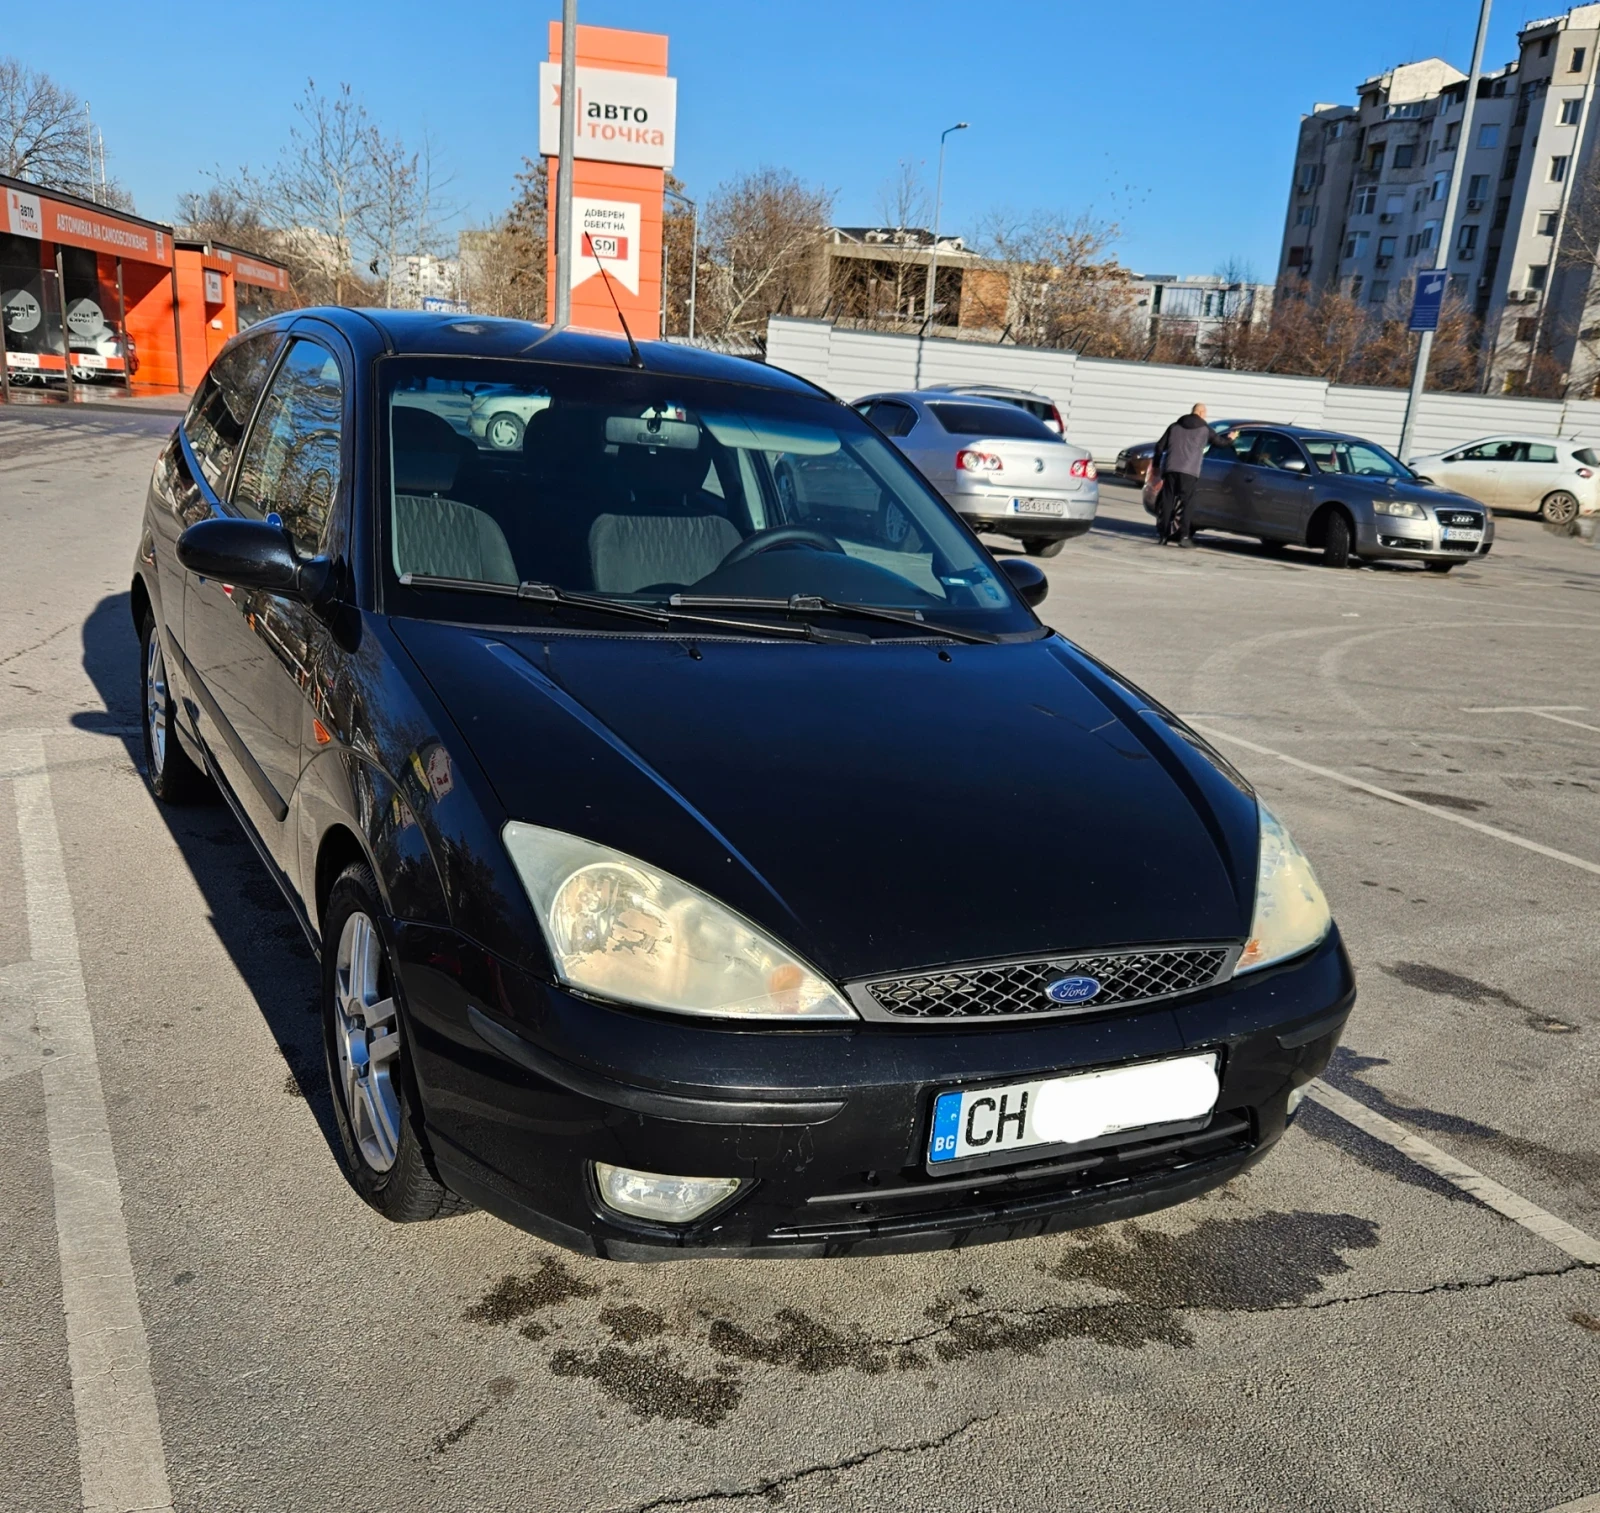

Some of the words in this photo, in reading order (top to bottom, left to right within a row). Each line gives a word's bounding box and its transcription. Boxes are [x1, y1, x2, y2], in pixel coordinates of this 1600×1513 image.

[588, 102, 648, 123] авто
[587, 122, 665, 146] точка
[585, 208, 625, 219] ДОВЕРЕН
[584, 219, 611, 230] ОБЕКТ
[613, 222, 625, 231] НА
[594, 239, 616, 252] SDI
[1060, 980, 1089, 998] Ford
[965, 1091, 1029, 1147] CH
[934, 1135, 955, 1152] BG
